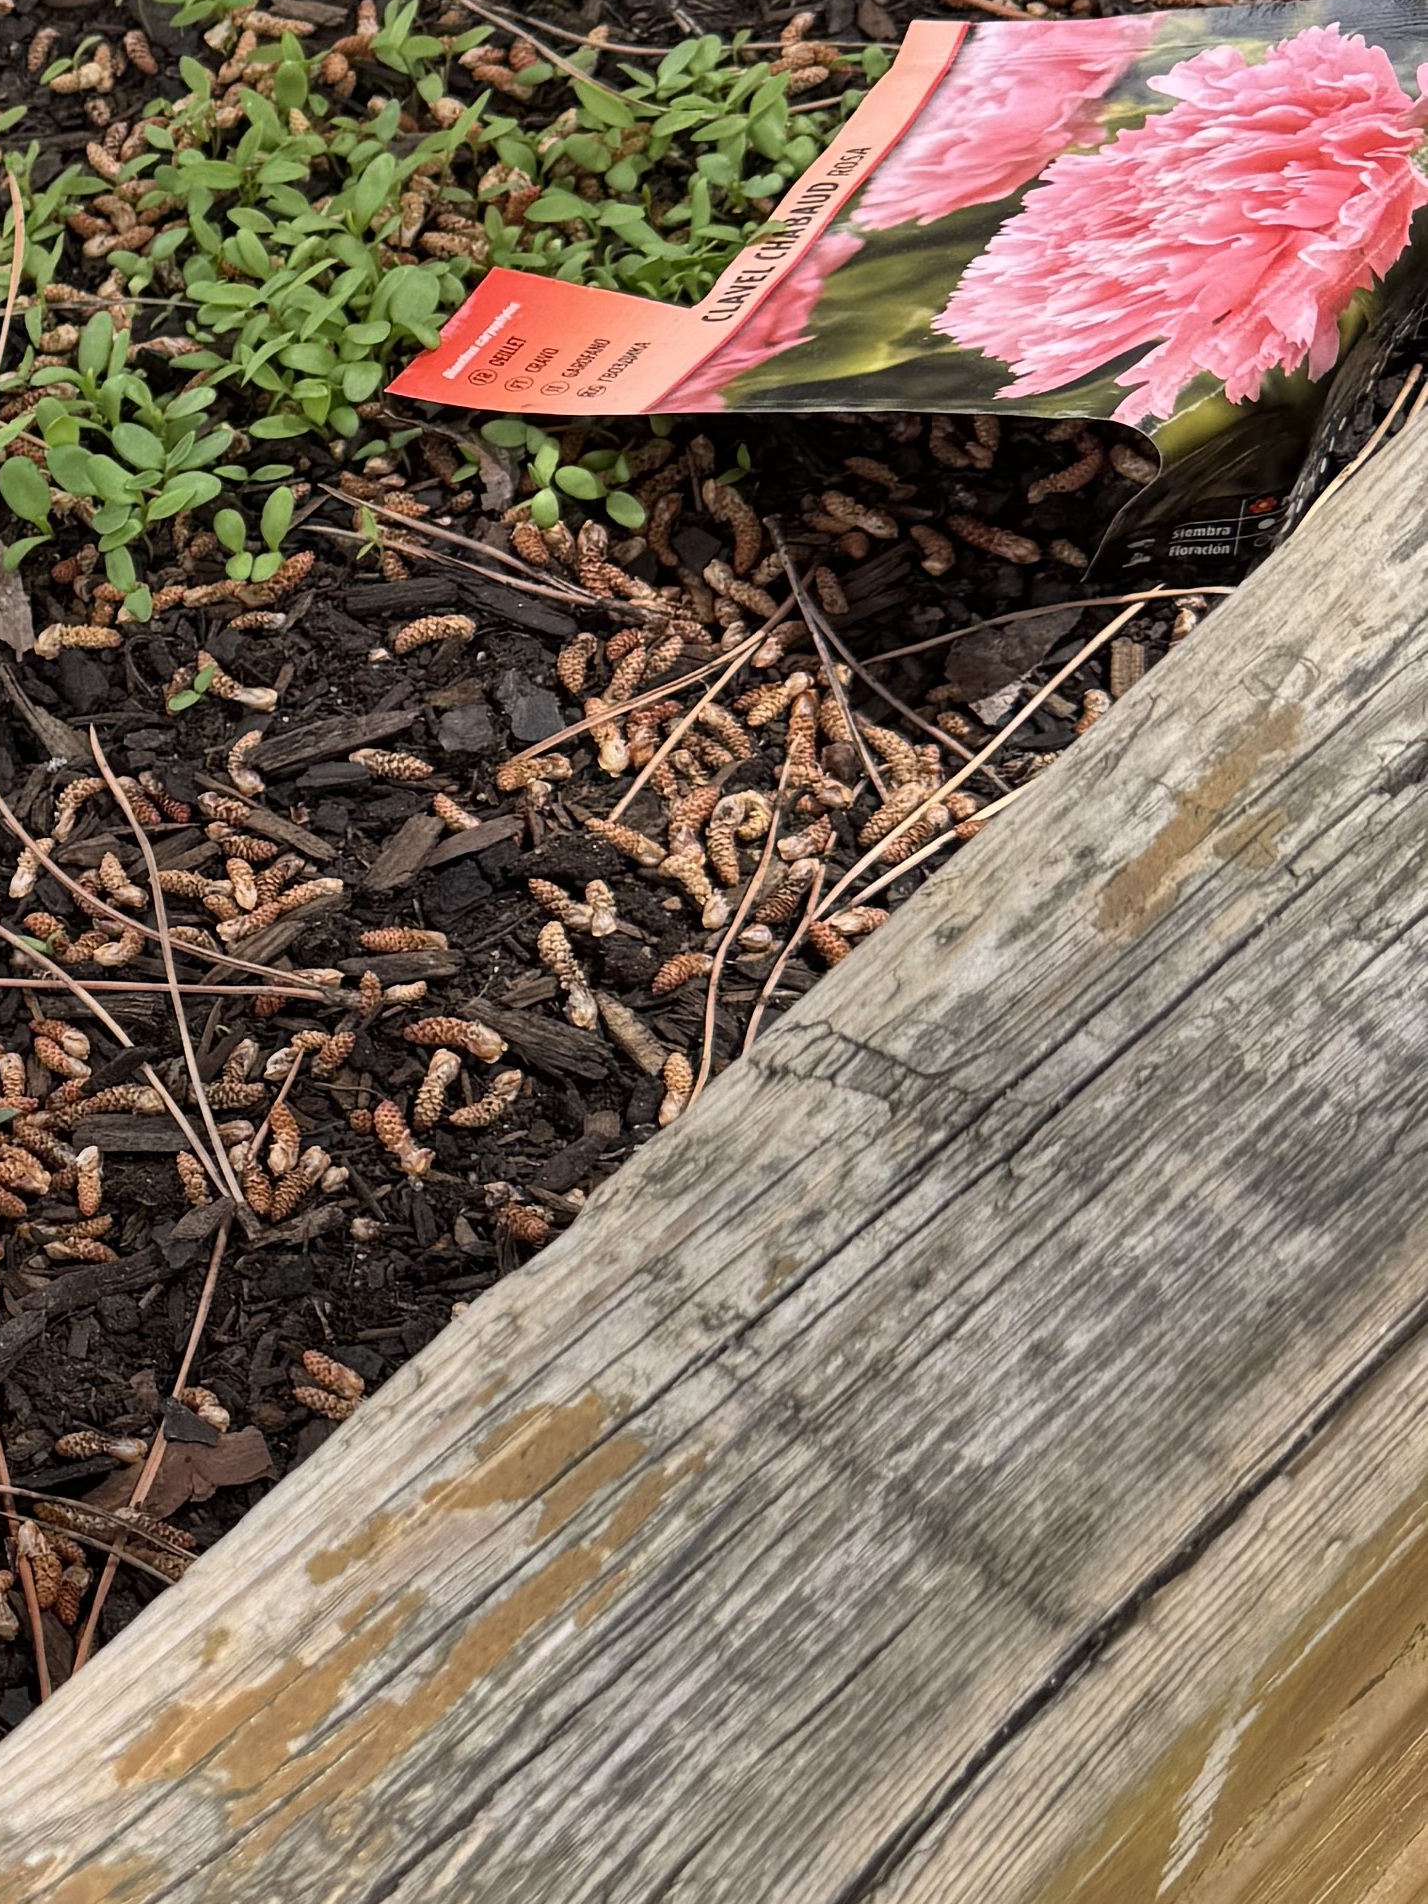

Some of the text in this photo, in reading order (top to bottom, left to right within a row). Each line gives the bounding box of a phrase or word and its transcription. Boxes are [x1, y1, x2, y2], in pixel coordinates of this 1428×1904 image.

[701, 147, 872, 322] CLAVEL CHABAUD ROSA
[524, 347, 560, 373] CRAVO
[561, 338, 611, 379] GAROFANO
[597, 341, 652, 384] ГВОЗДИКА
[1171, 525, 1231, 539] Siembra
[1169, 543, 1231, 556] Floración
